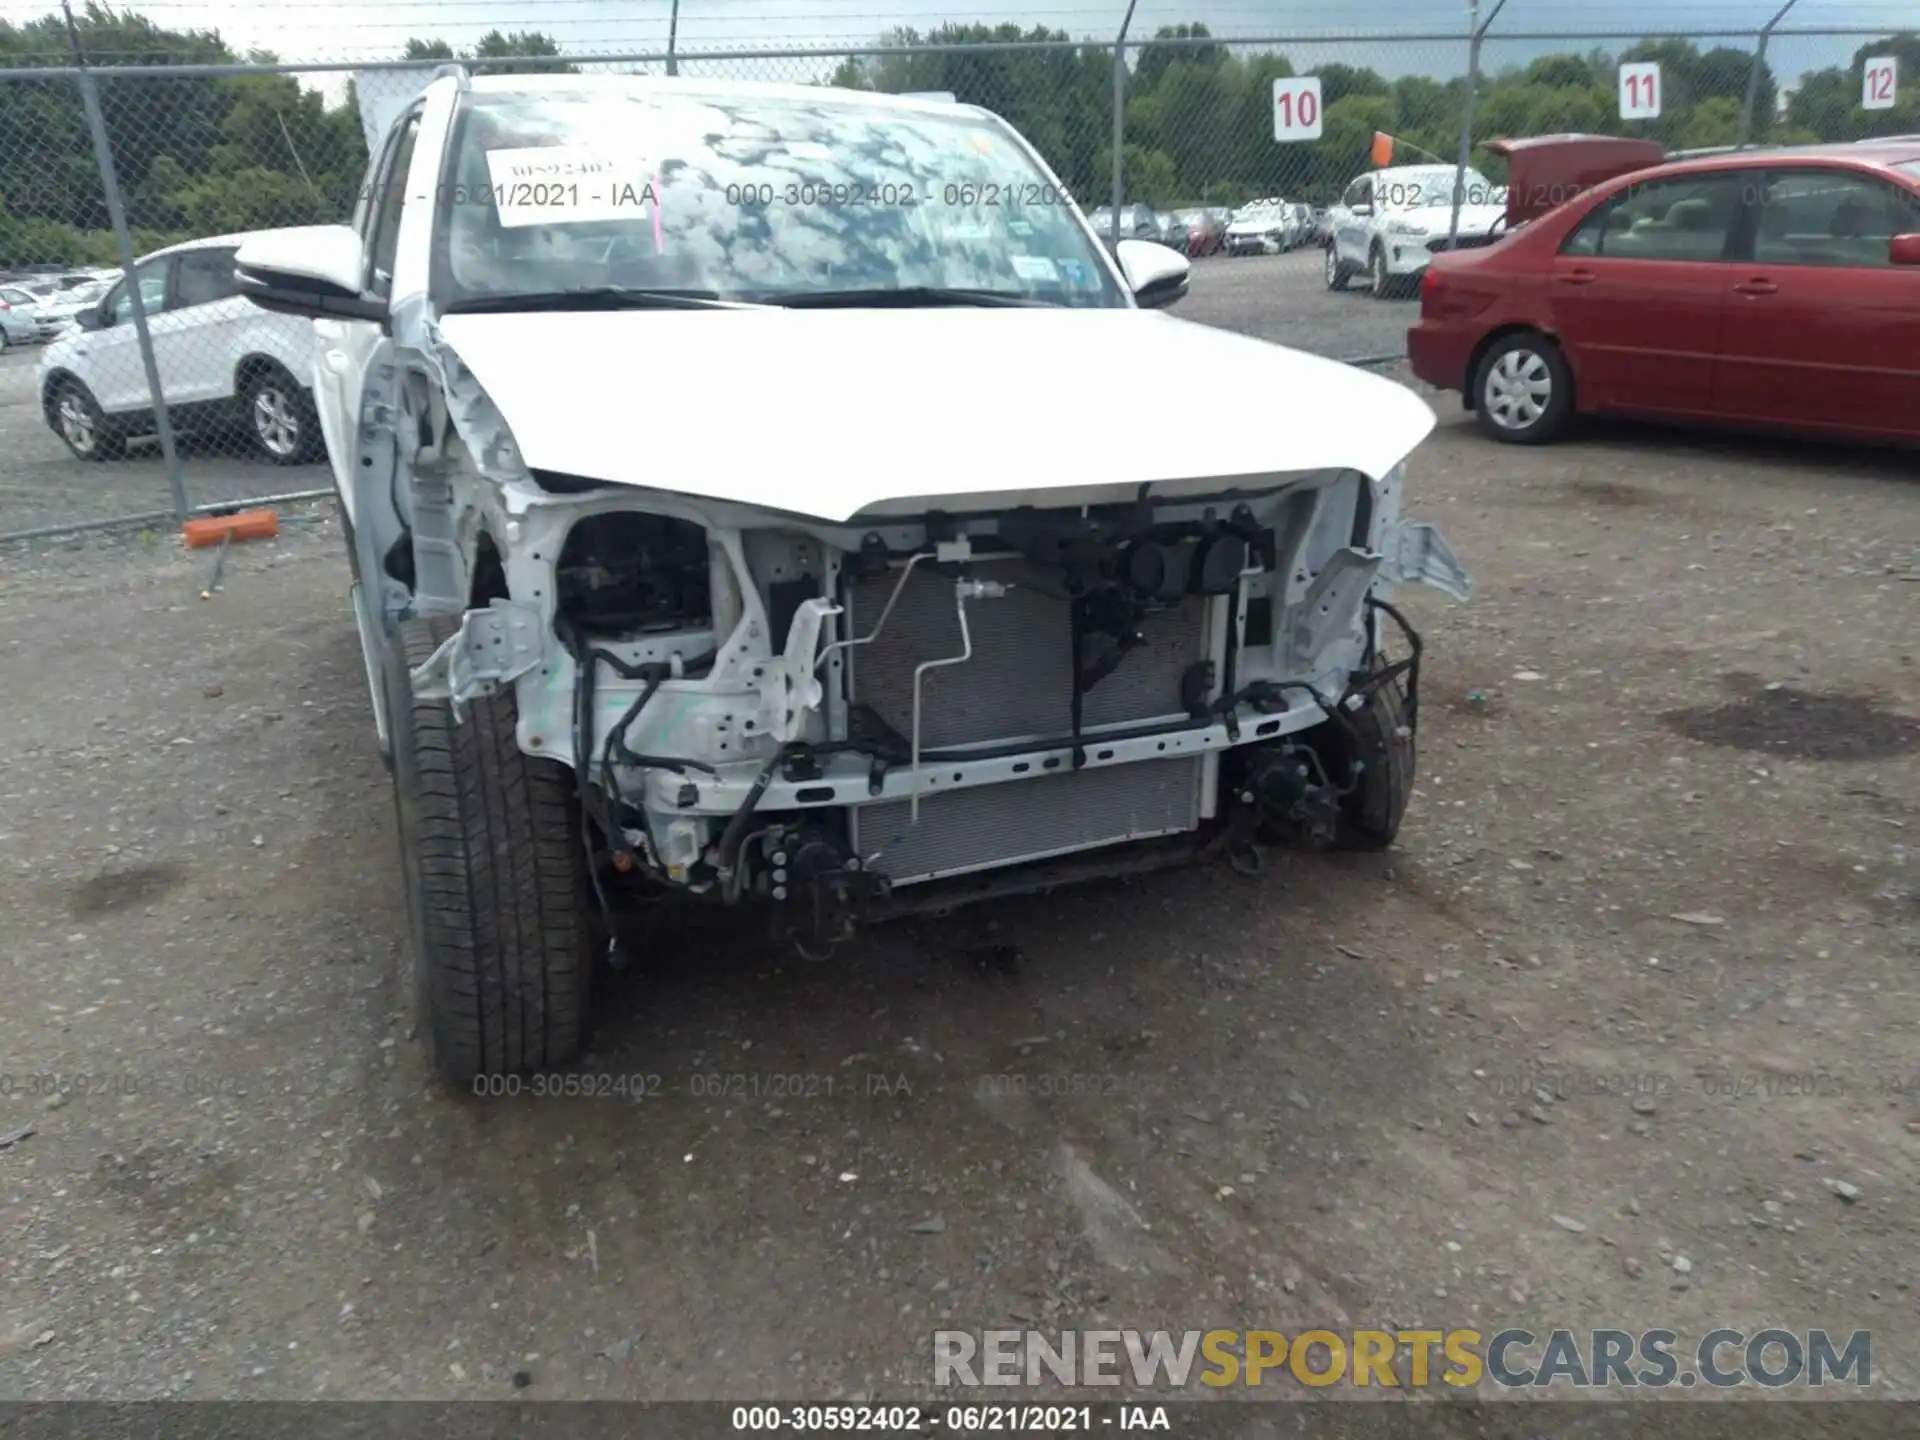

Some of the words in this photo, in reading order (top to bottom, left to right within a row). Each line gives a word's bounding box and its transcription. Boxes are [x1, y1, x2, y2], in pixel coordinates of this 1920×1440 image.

[1626, 74, 1654, 109] 11
[1867, 67, 1893, 100] 12
[1278, 91, 1317, 128] 10
